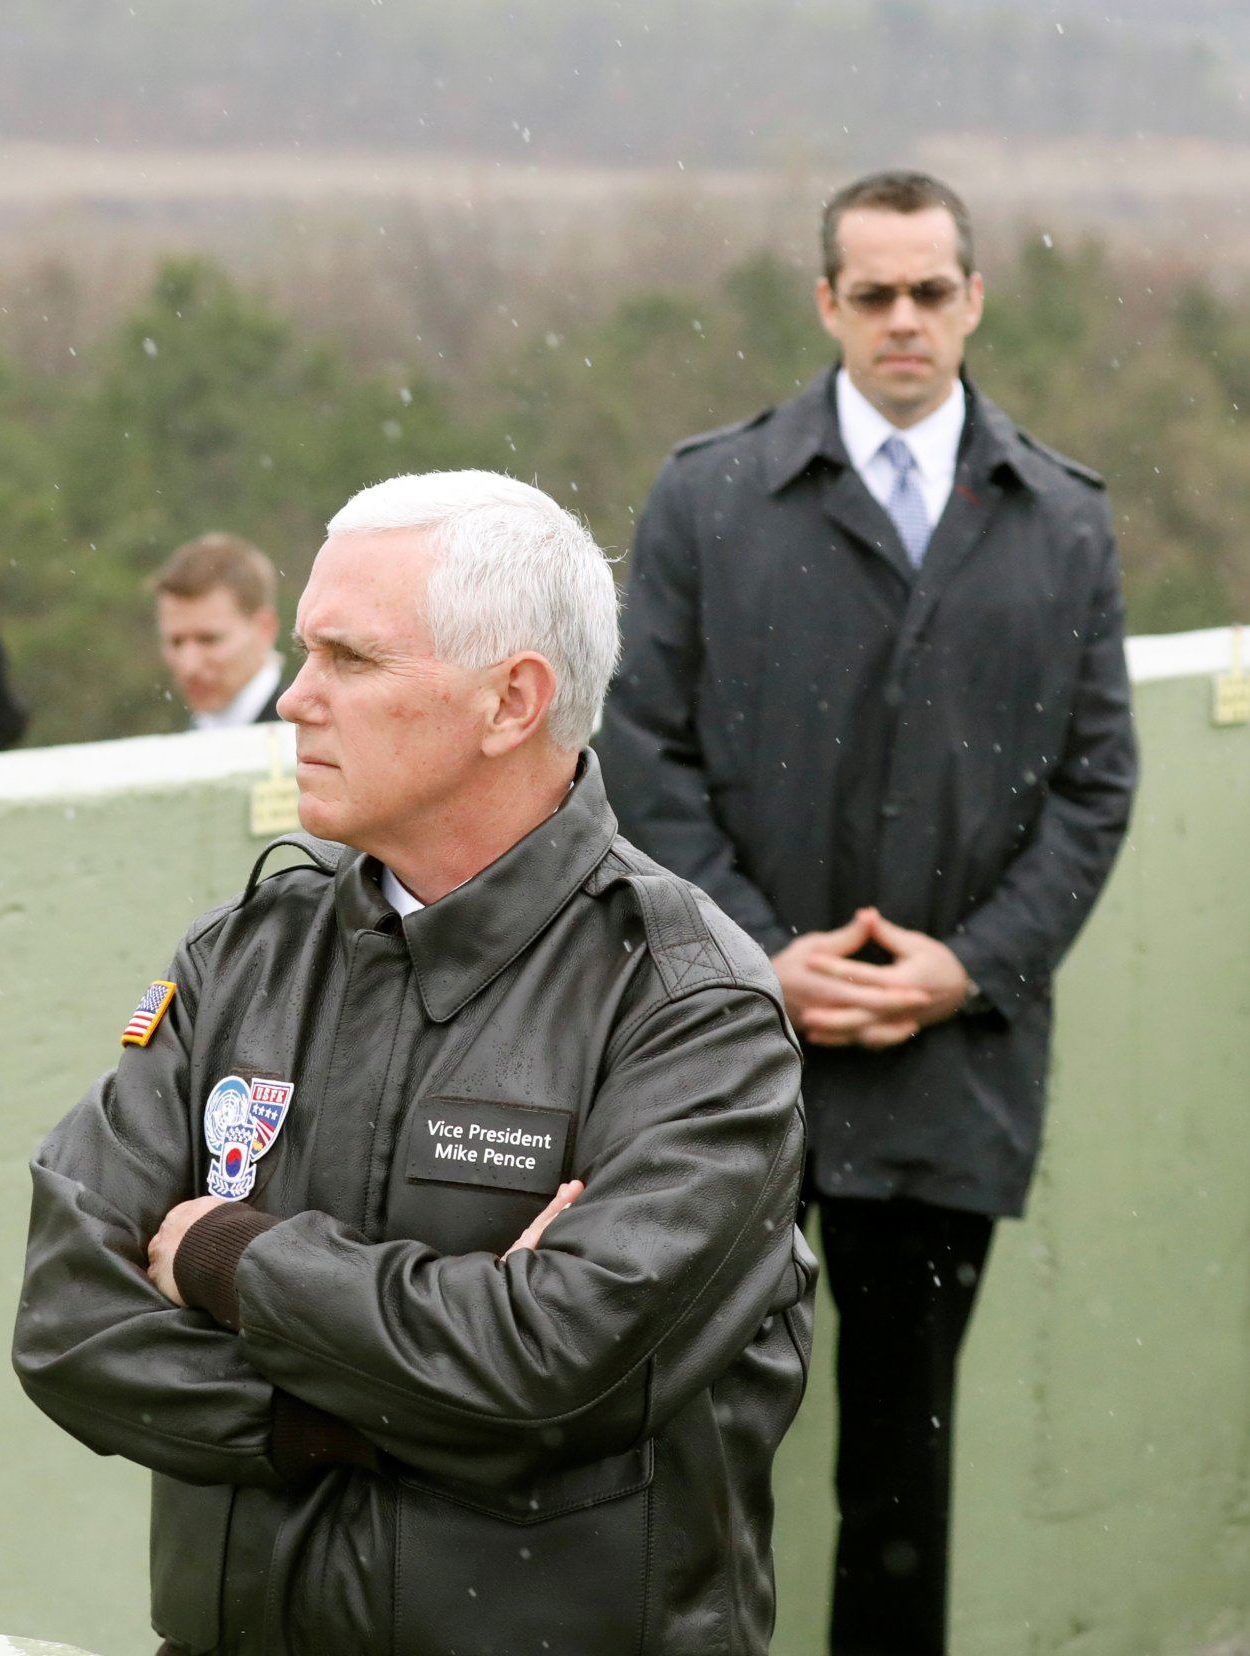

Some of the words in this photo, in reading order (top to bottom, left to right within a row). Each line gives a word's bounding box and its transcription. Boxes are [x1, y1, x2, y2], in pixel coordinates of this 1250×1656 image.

[255, 1086, 285, 1103] USFK
[427, 1119, 463, 1139] Vice
[468, 1124, 552, 1149] President
[434, 1142, 478, 1162] Mike
[482, 1148, 536, 1170] Pence
